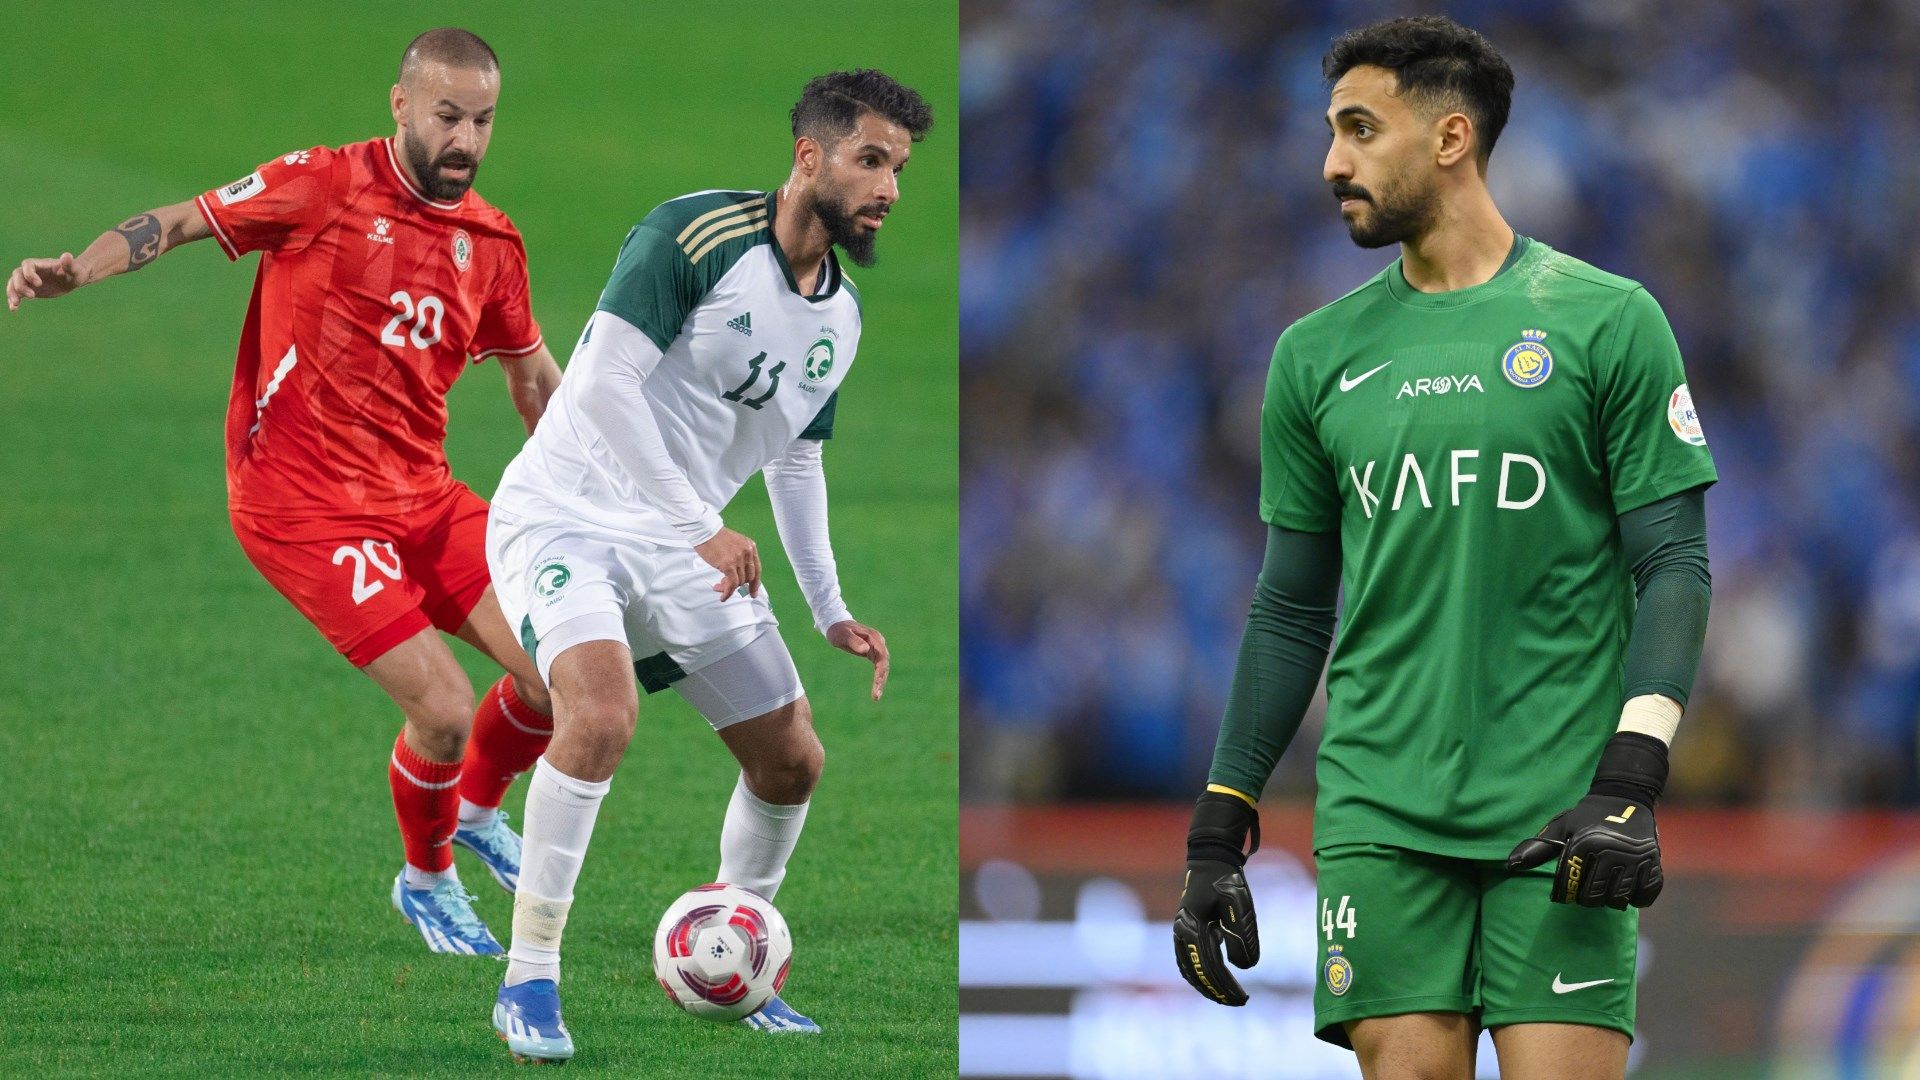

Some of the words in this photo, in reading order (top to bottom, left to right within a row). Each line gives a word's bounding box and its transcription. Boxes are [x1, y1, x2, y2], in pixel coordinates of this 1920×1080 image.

[366, 233, 394, 245] KELME
[381, 291, 444, 350] 20
[726, 320, 753, 337] adidas
[721, 351, 788, 411] 11
[797, 381, 817, 394] SAUDI
[1395, 374, 1485, 400] AROYA
[1349, 449, 1547, 519] KAFD
[332, 538, 402, 605] 20
[545, 594, 565, 608] SAUDI
[1321, 895, 1358, 941] 44
